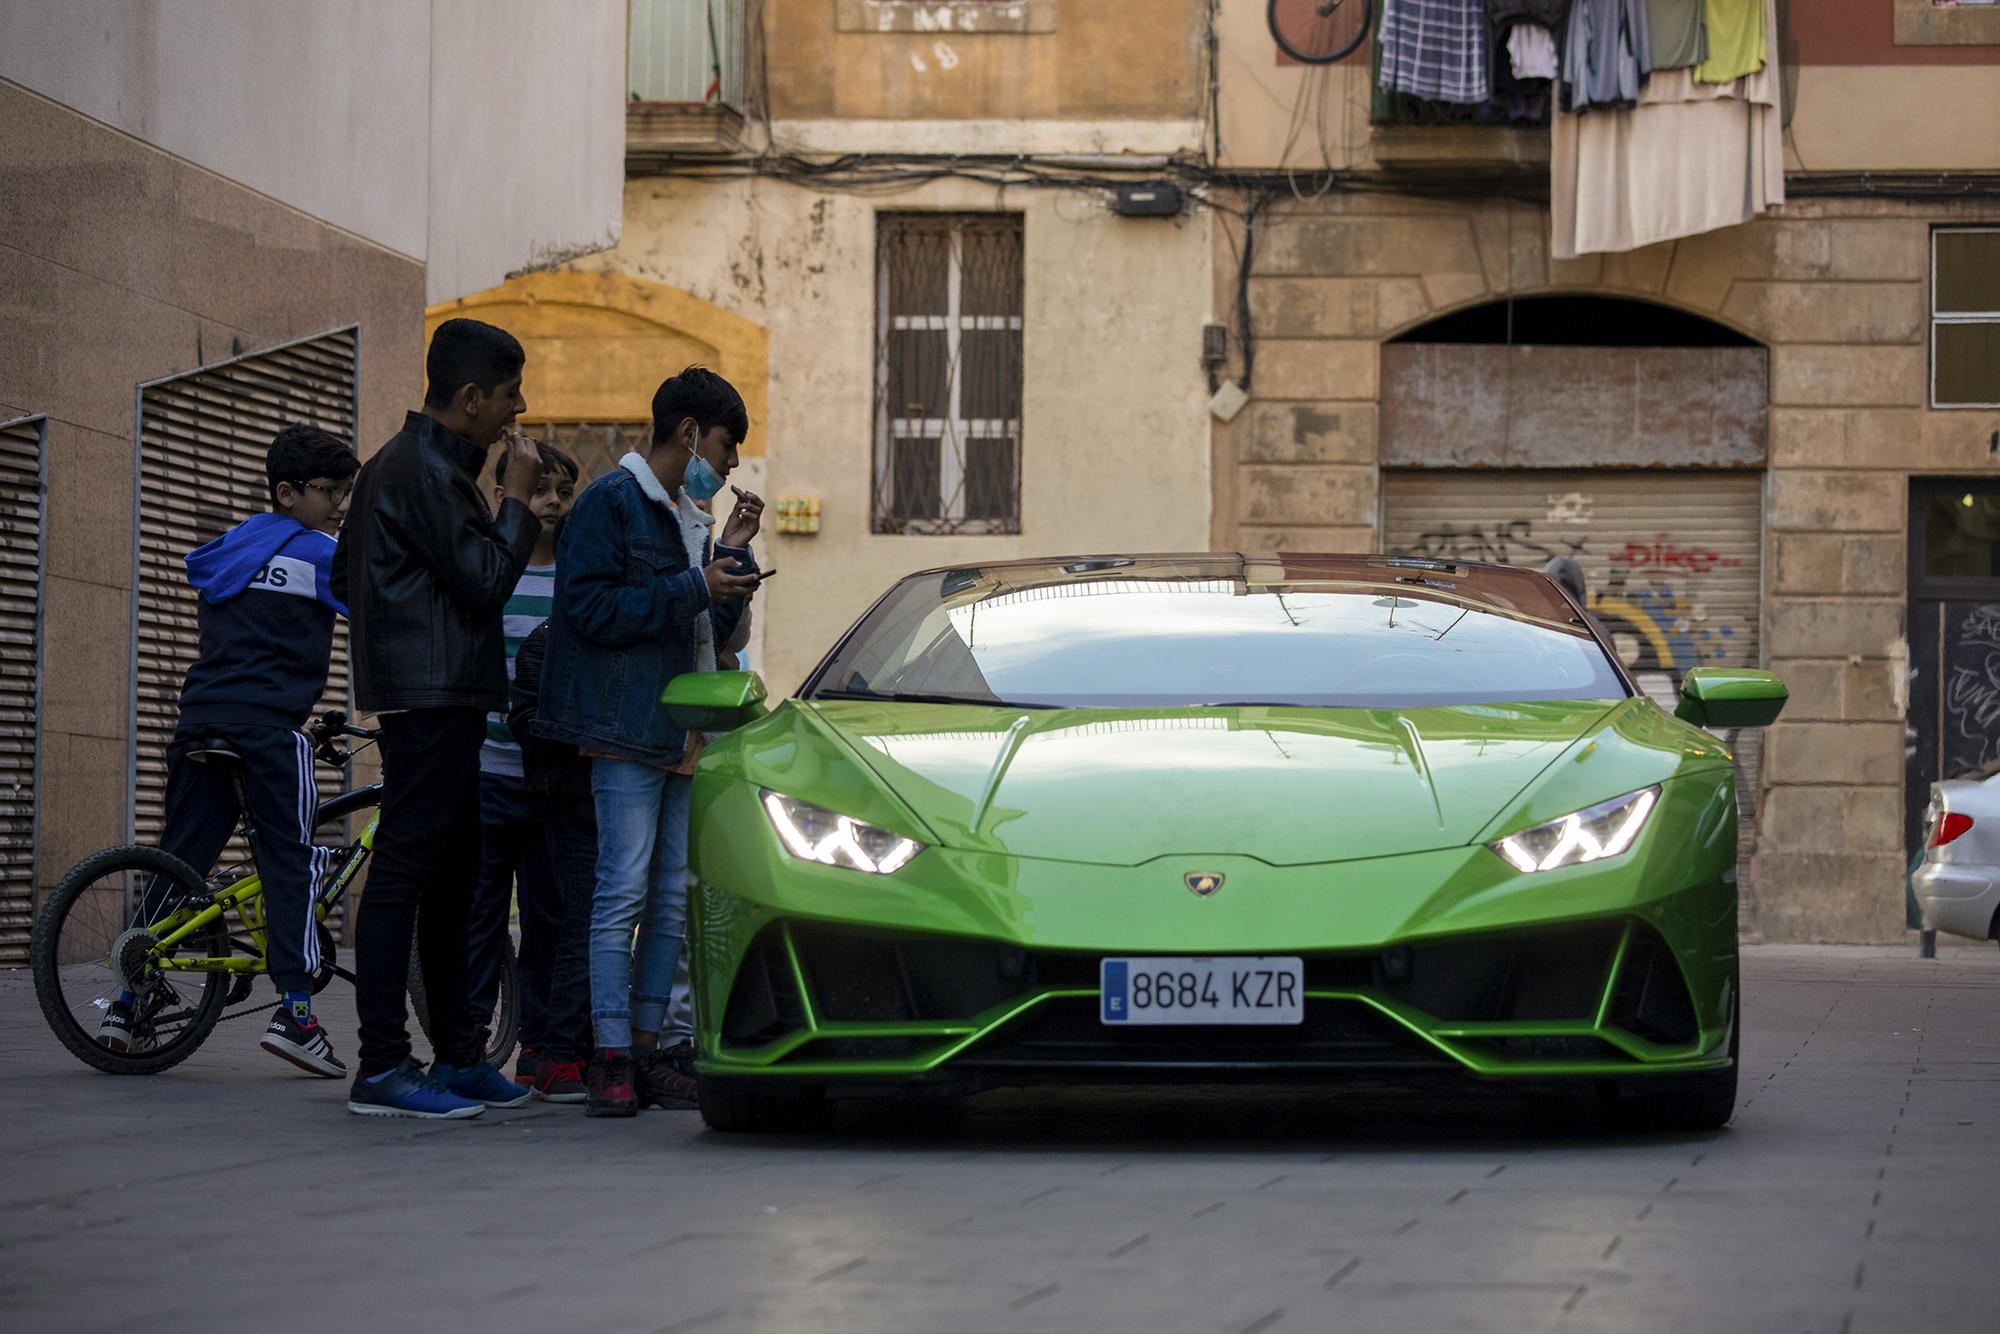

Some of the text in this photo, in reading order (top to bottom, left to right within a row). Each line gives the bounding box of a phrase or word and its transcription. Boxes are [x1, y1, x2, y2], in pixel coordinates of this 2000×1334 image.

[1133, 971, 1296, 1009] 8684 KZR
[1110, 997, 1122, 1011] E
